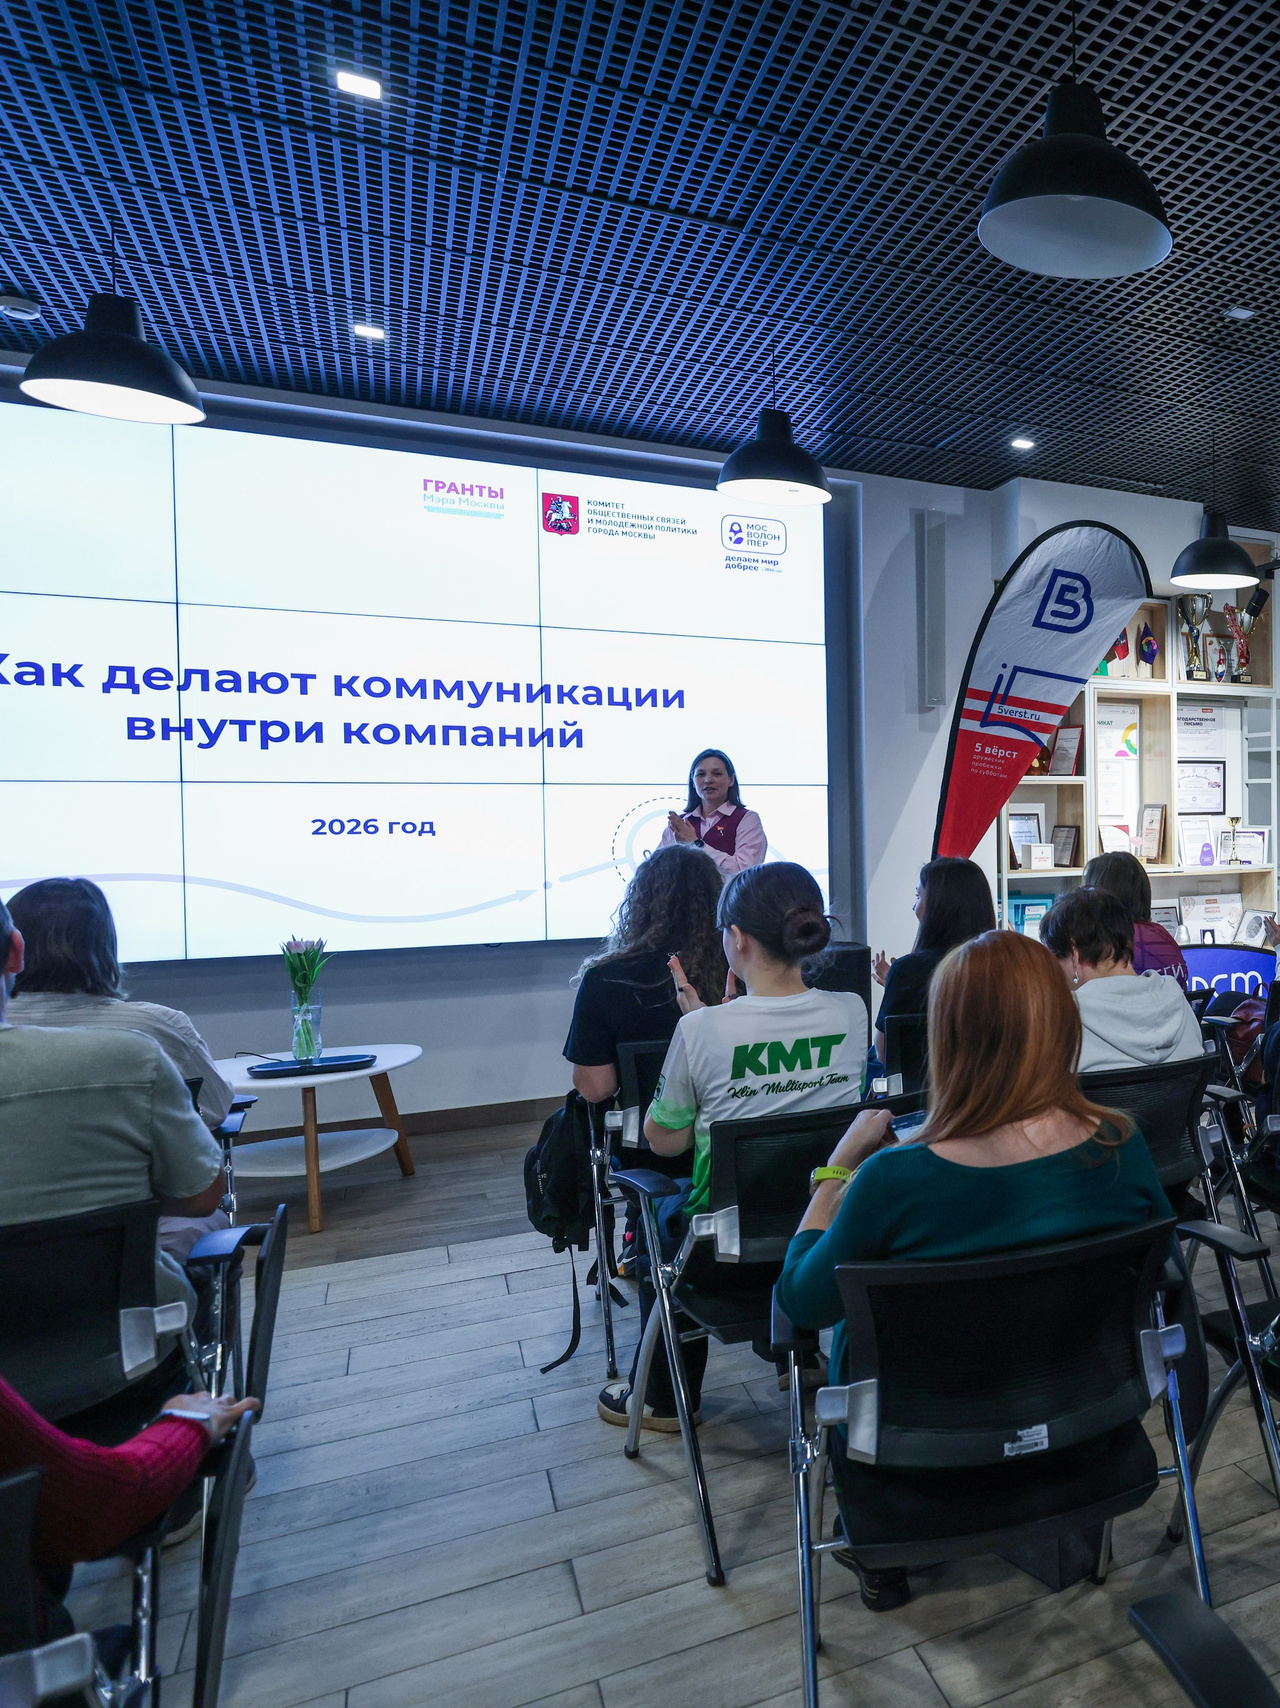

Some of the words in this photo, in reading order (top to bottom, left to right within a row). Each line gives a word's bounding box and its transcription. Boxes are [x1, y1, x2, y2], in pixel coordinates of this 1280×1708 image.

[423, 478, 504, 499] ГРАНТЫ
[423, 493, 455, 506] Мэра
[459, 497, 504, 510] Москвы
[587, 500, 625, 510] КОМИТЕТ
[587, 508, 654, 522] ОБЩЕСТВЕННЫХ
[656, 516, 686, 526] СВЯЗЕЙ
[587, 526, 620, 537] ГОРОДА
[621, 530, 656, 540] МОСКВЫ
[655, 525, 698, 536] ПОЛИТИКИ
[746, 523, 768, 532] МОС
[746, 531, 780, 541] ВОЛОН
[724, 555, 759, 564] делаем
[725, 562, 759, 571] добрее
[102, 665, 317, 695] делают
[333, 674, 686, 711] коммуникации
[997, 705, 1041, 721] 5verst.ru
[126, 716, 324, 750] внутри
[343, 720, 583, 748] компаний
[974, 742, 983, 752] 5
[984, 745, 1018, 759] вёрст
[971, 761, 1002, 770] пробежки
[972, 754, 1006, 764] дружеские
[979, 769, 1008, 778] субботам
[311, 818, 379, 836] 2026
[388, 820, 436, 837] год
[730, 1033, 847, 1080] KMT
[727, 1086, 758, 1099] Klin
[761, 1077, 826, 1096] Multisport
[825, 1073, 850, 1085] Team
